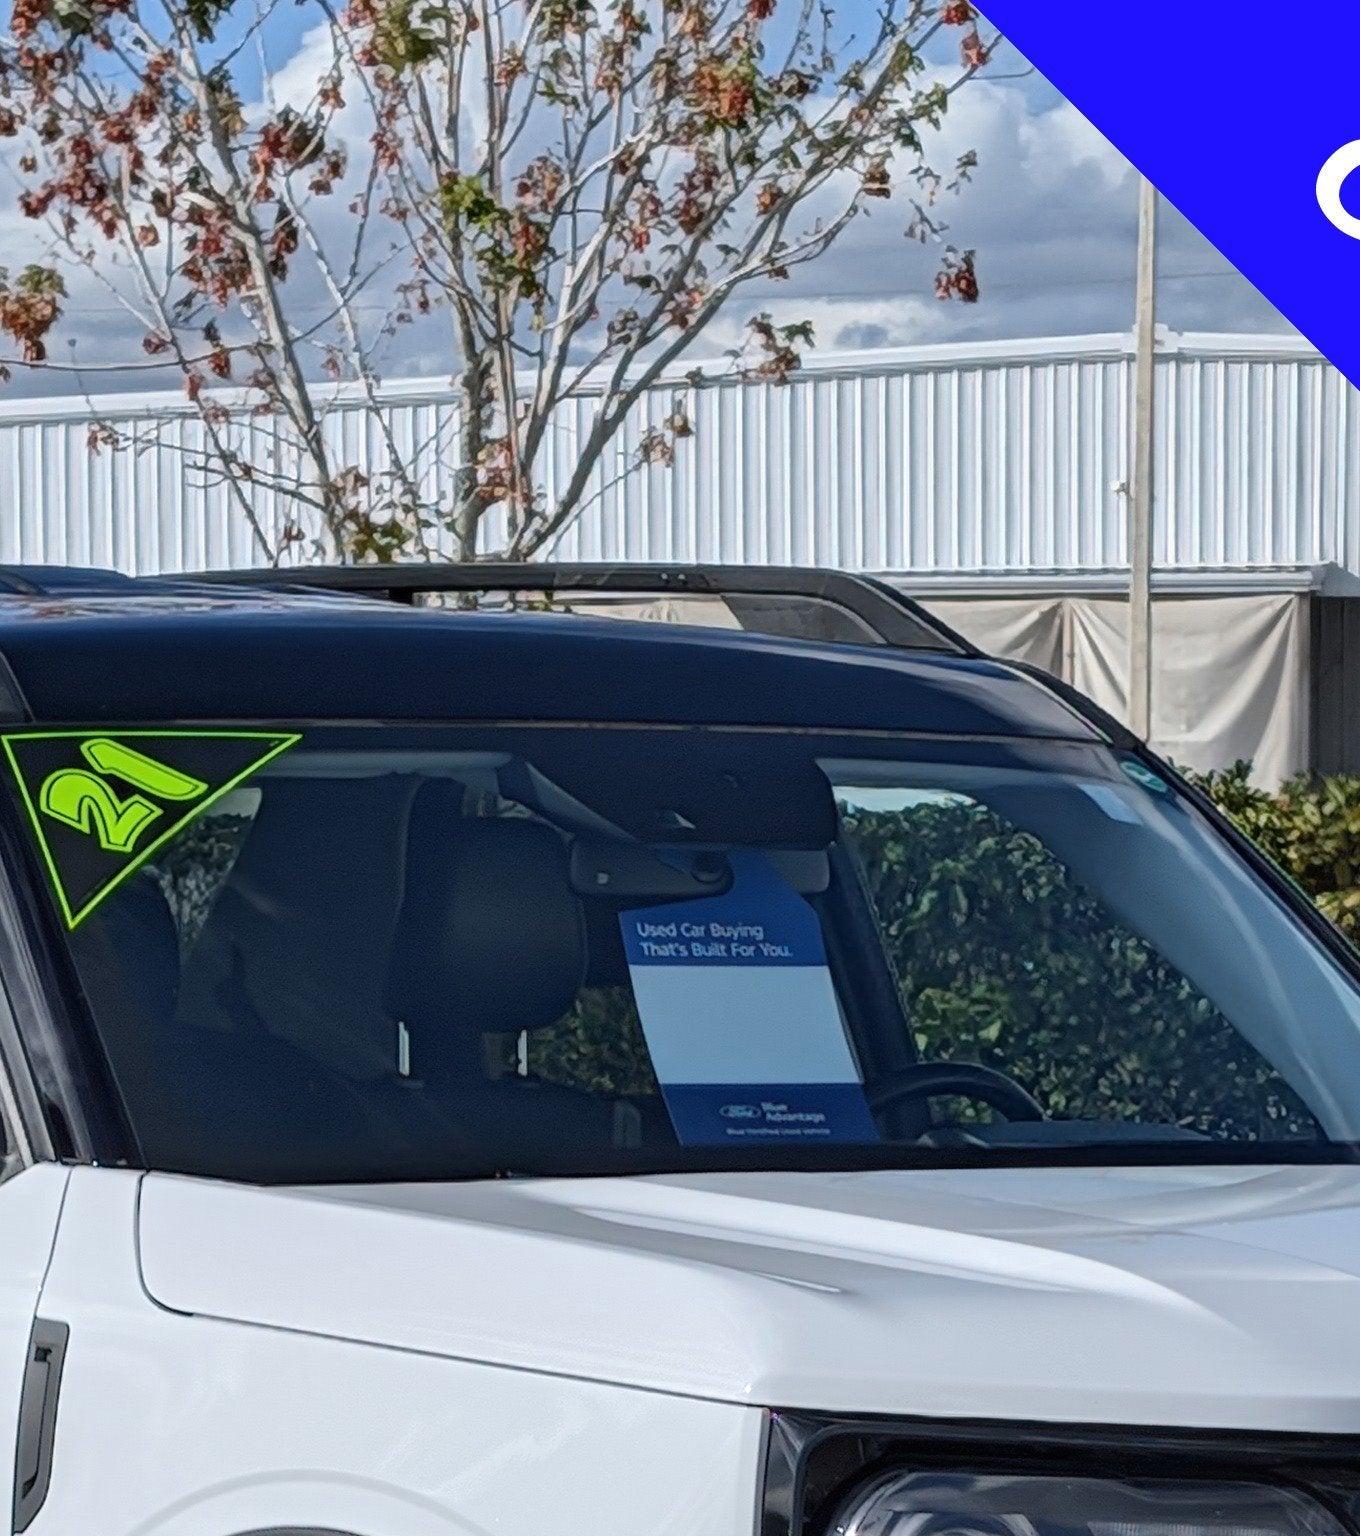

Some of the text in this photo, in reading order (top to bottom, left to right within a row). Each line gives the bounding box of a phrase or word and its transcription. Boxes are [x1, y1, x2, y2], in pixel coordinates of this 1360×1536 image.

[39, 738, 209, 853] 21
[636, 921, 765, 941] Used Car Buying
[640, 942, 794, 958] That's Built For You.
